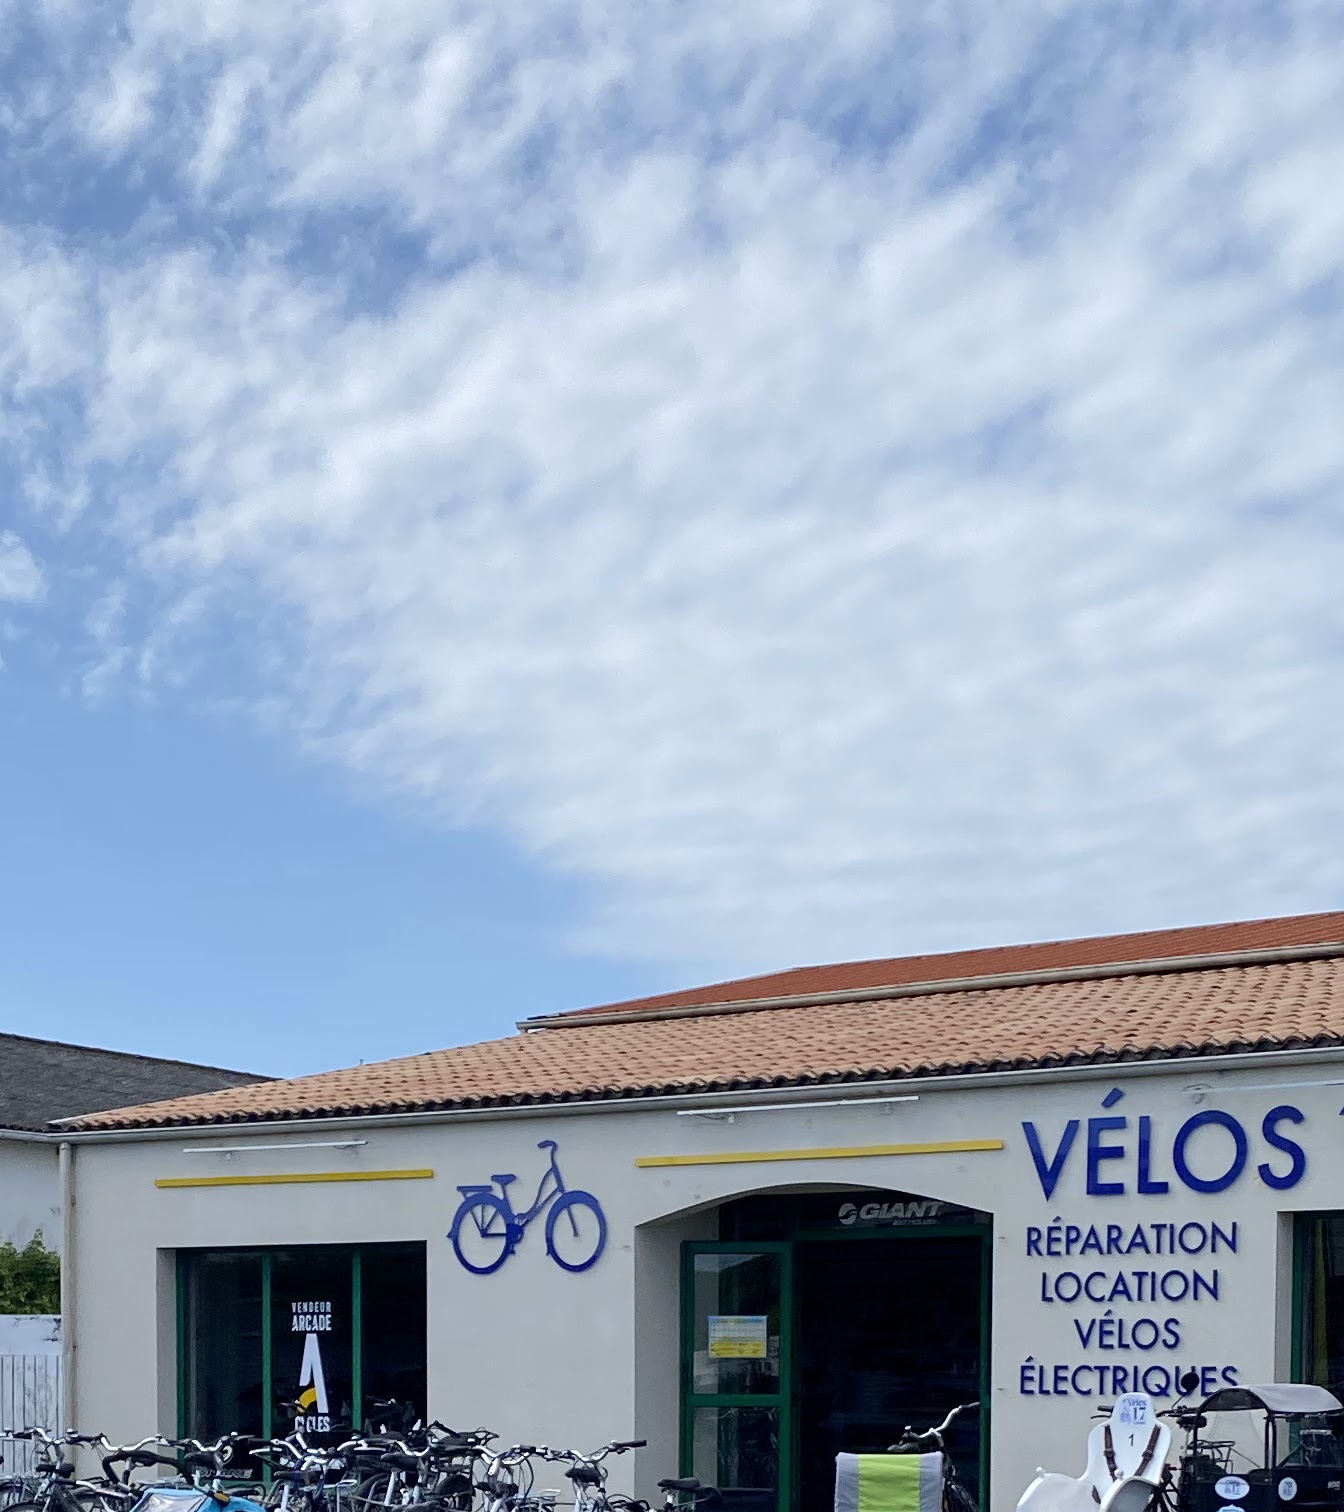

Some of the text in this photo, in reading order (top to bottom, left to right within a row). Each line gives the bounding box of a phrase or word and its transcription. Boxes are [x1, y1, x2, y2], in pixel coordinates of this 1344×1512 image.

[1021, 1087, 1307, 1201] VÉLOS
[859, 1201, 944, 1220] GIANT
[1025, 1215, 1238, 1257] RÉPARATION
[1040, 1268, 1220, 1303] LOCATION
[291, 1301, 332, 1313] VENDEUR
[291, 1313, 332, 1332] ARCADE
[1073, 1309, 1181, 1351] VÉLOS
[1019, 1355, 1239, 1397] ÉLECTRIQUES
[294, 1415, 331, 1433] CCLES
[1128, 1433, 1135, 1447] 1
